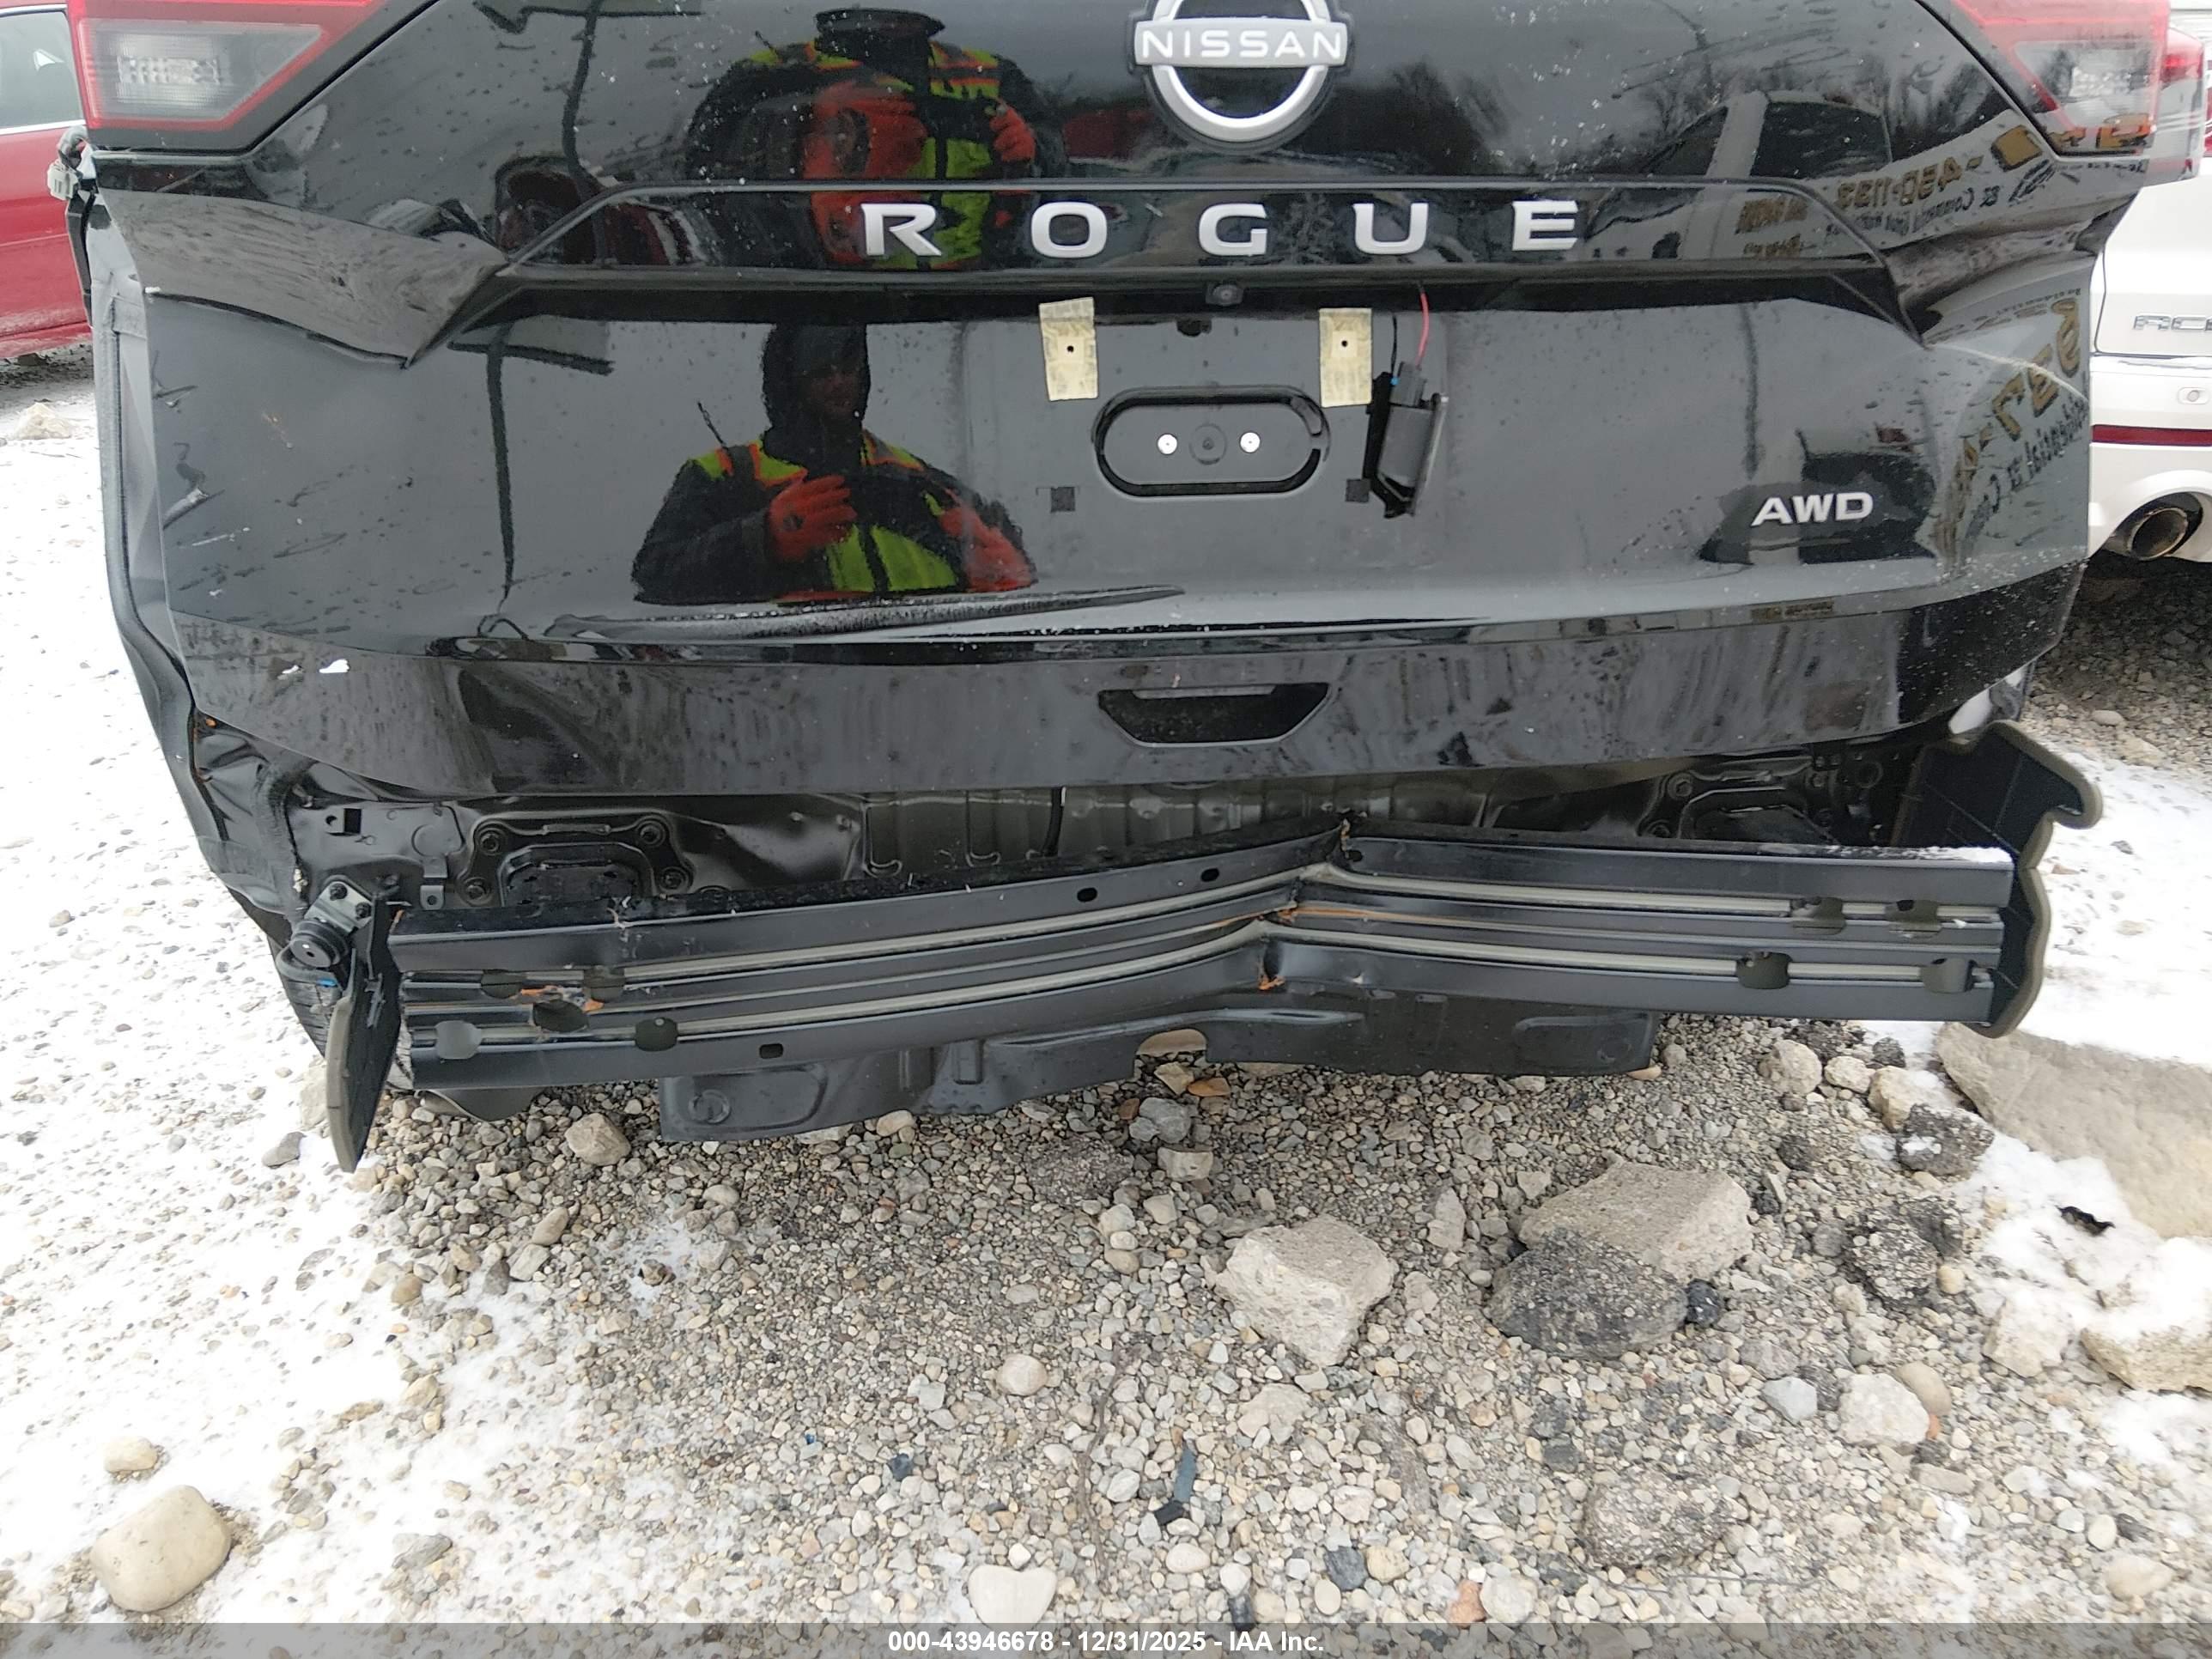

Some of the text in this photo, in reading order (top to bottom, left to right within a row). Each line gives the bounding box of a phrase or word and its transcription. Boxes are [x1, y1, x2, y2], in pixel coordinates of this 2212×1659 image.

[1142, 29, 1341, 58] NISSAN
[861, 198, 1579, 258] ROGUE
[1751, 491, 1874, 527] AWD
